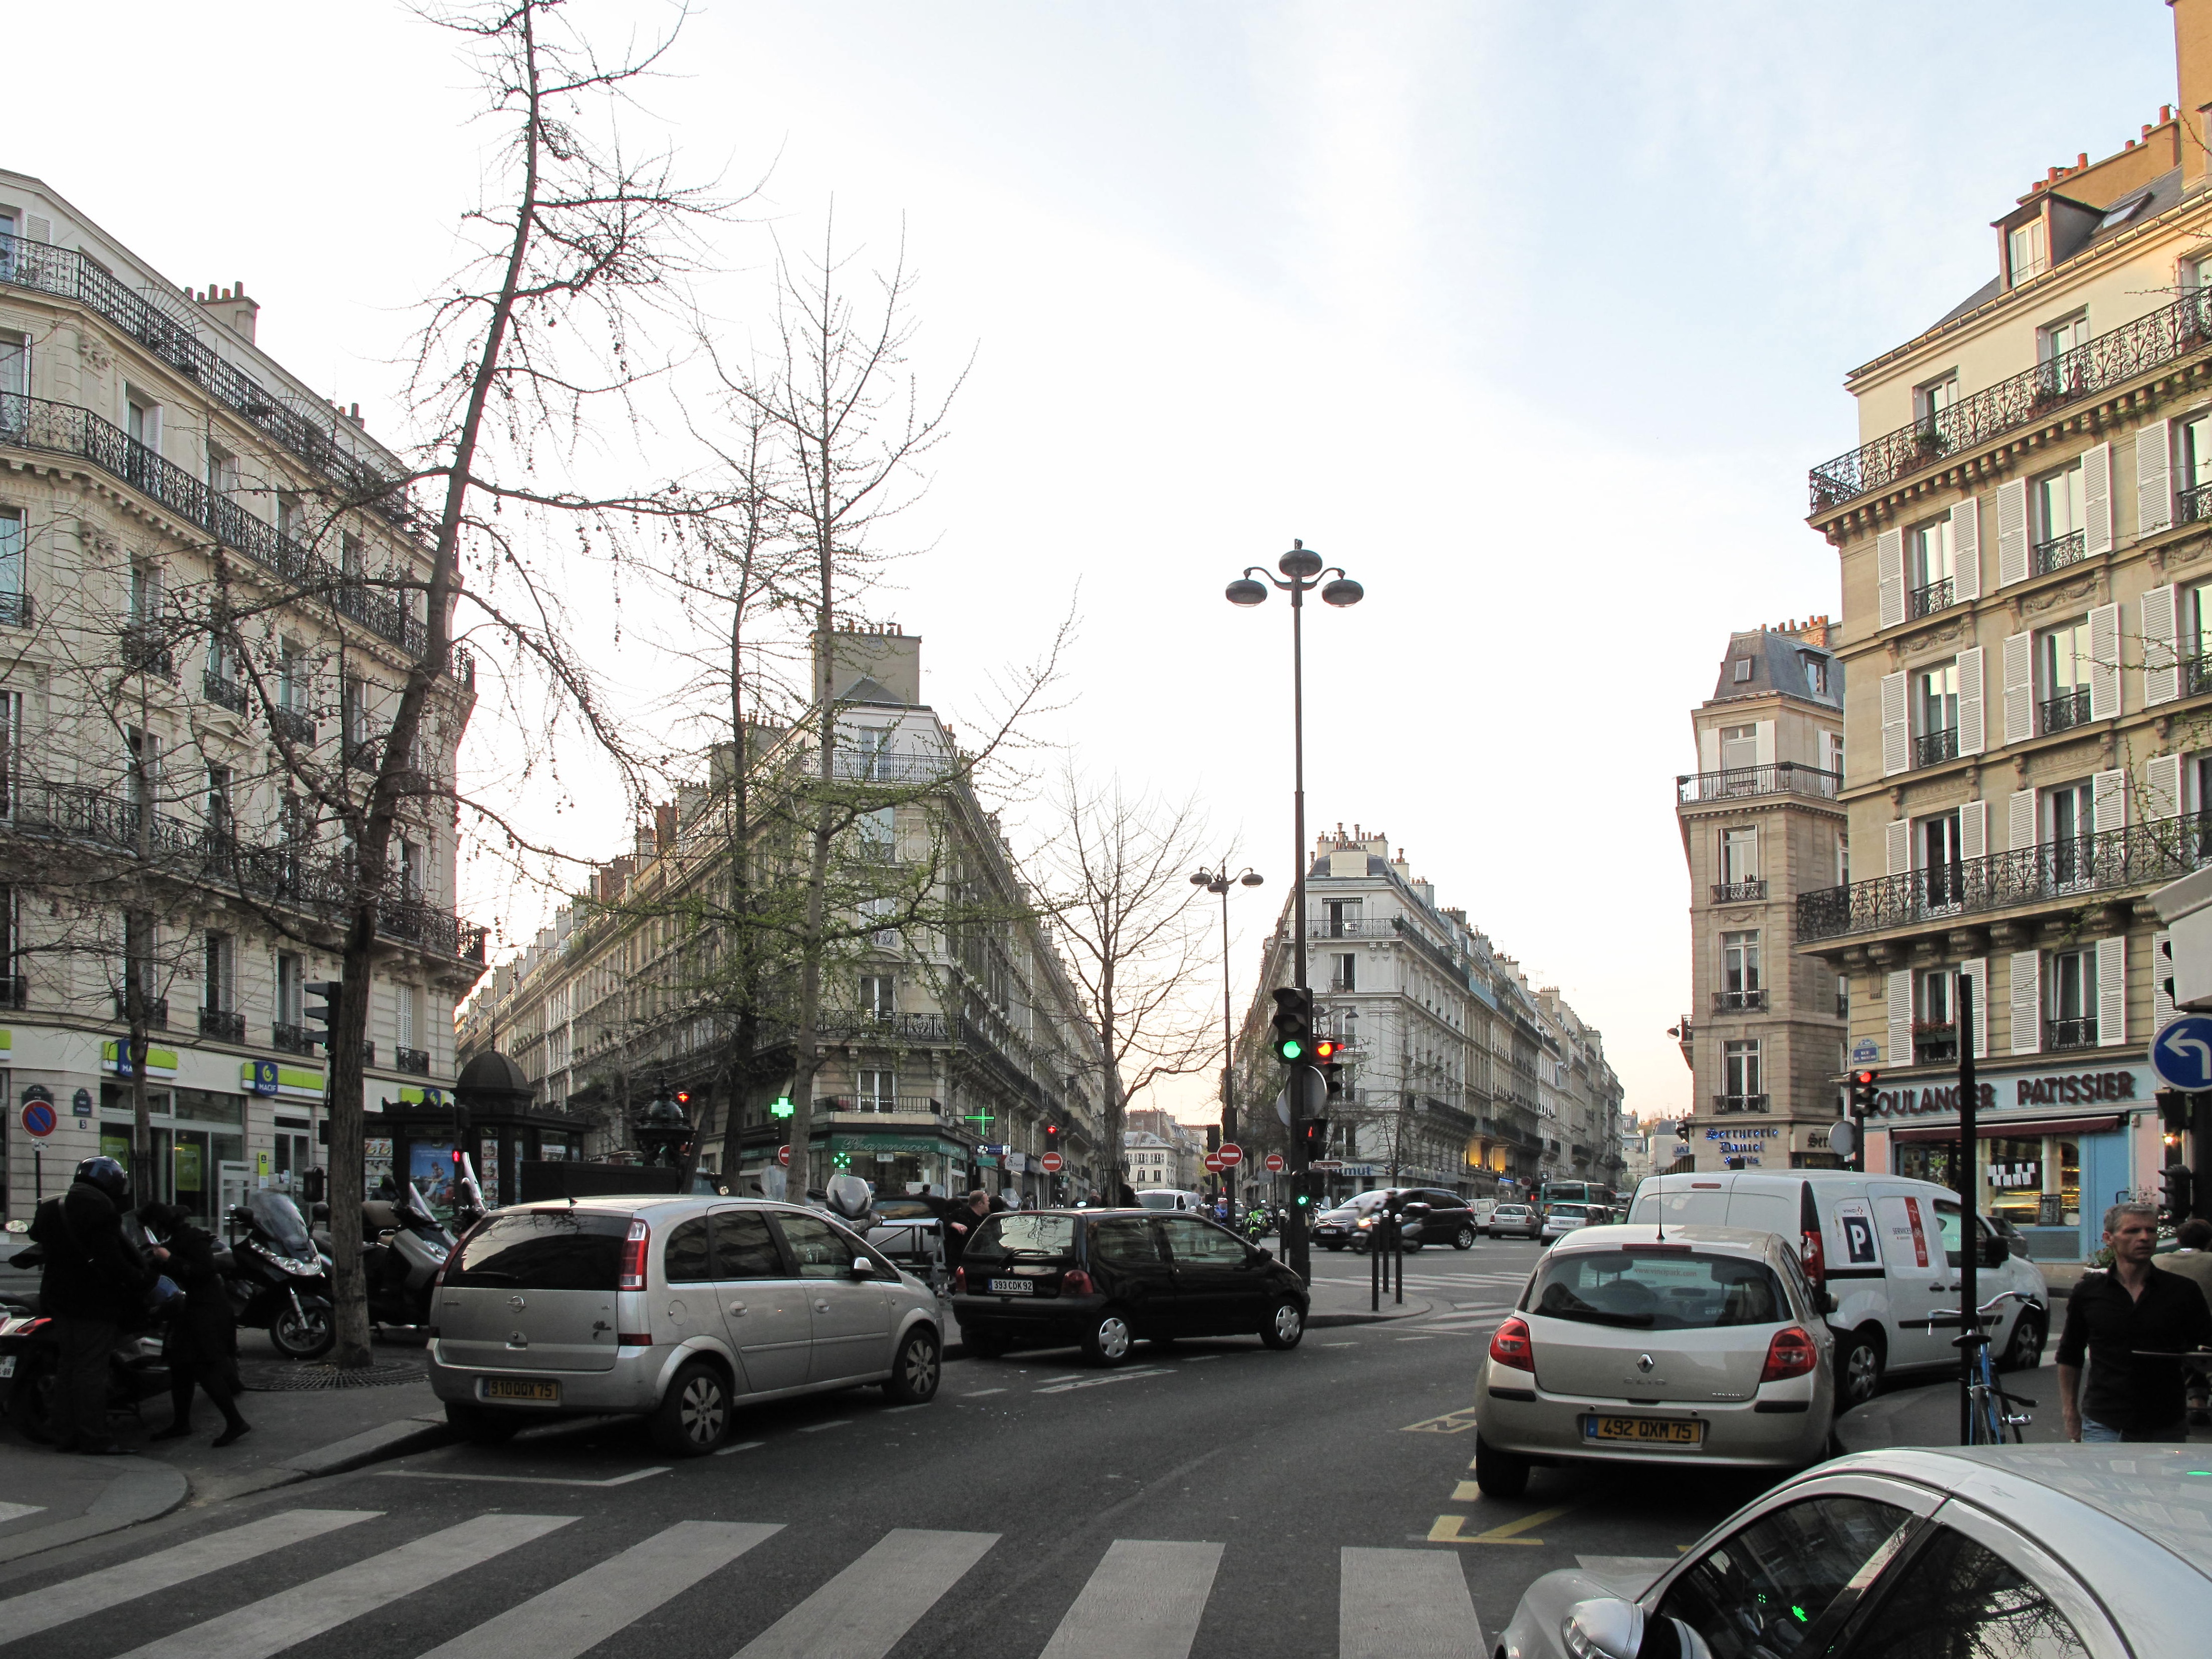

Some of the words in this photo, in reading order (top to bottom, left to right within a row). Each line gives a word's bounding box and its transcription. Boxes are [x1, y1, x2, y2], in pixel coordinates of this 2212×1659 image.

[258, 1083, 276, 1091] MACIF
[2017, 1071, 2134, 1106] PATISSIER
[841, 1139, 930, 1152] Pharmacie
[1719, 1141, 1765, 1153] Daniel
[1850, 1225, 1866, 1254] P
[994, 1281, 1007, 1289] 393
[1008, 1281, 1022, 1290] CDK
[1023, 1281, 1032, 1290] 92
[538, 1384, 551, 1397] 75
[1603, 1420, 1633, 1436] 492
[1639, 1421, 1669, 1438] QXM
[1673, 1423, 1692, 1439] 75
